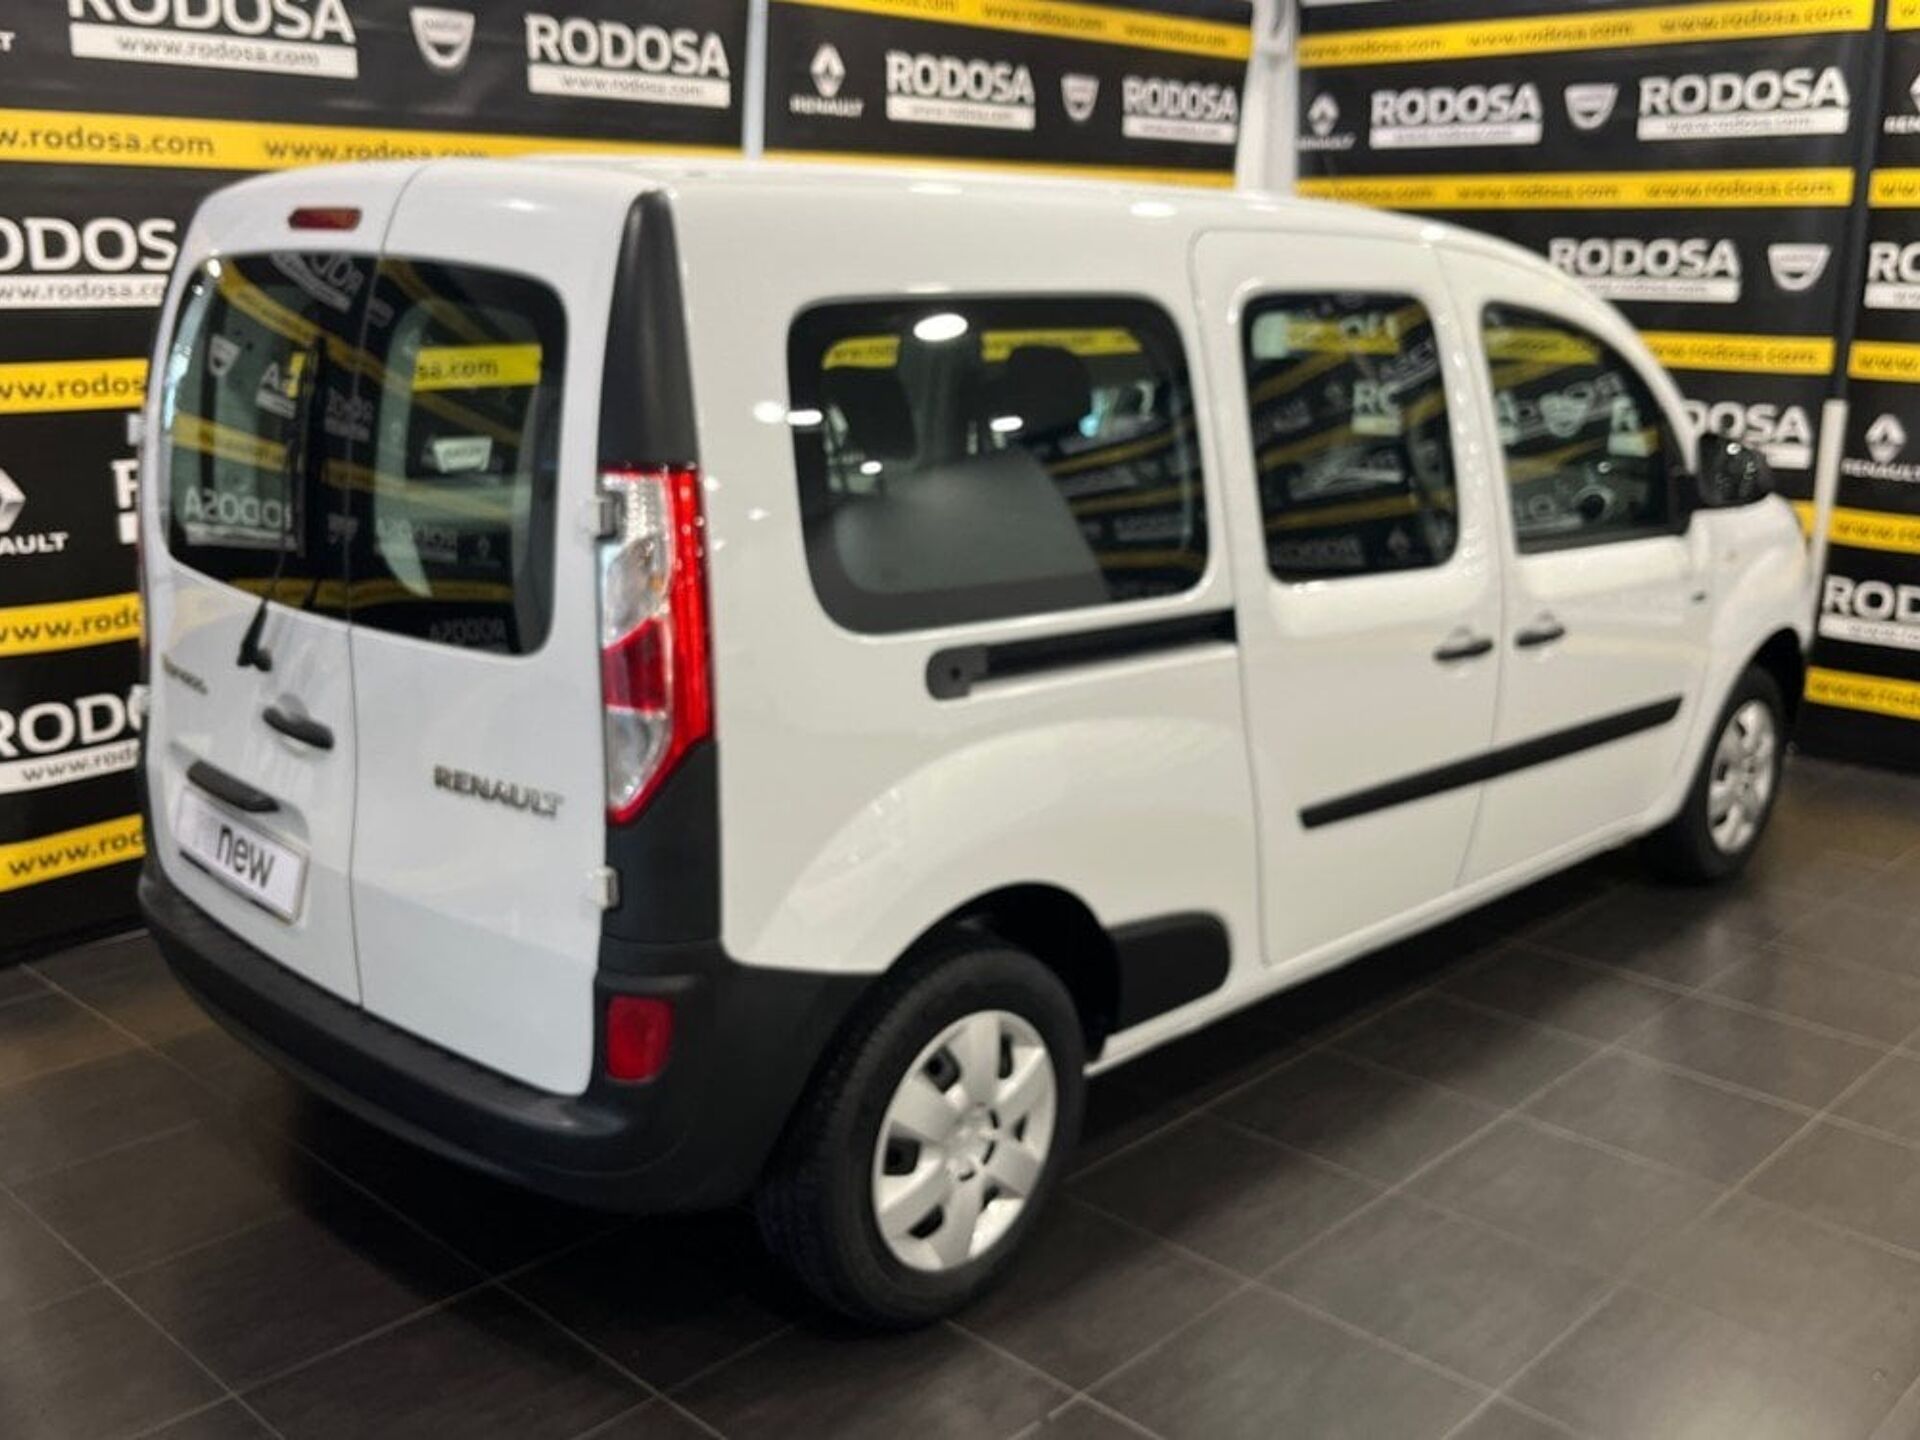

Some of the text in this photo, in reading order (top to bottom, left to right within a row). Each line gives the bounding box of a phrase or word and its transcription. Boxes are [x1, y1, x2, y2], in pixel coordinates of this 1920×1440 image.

[116, 35, 321, 68] www.rodosa.com
[526, 13, 731, 79] RODOSA
[885, 50, 1036, 105] RODOSA
[1122, 74, 1239, 124] RODOSA
[1638, 66, 1849, 115] RODOSA
[1370, 81, 1542, 127] RODOSA
[433, 763, 566, 820] RENAULT
[217, 823, 276, 889] new
